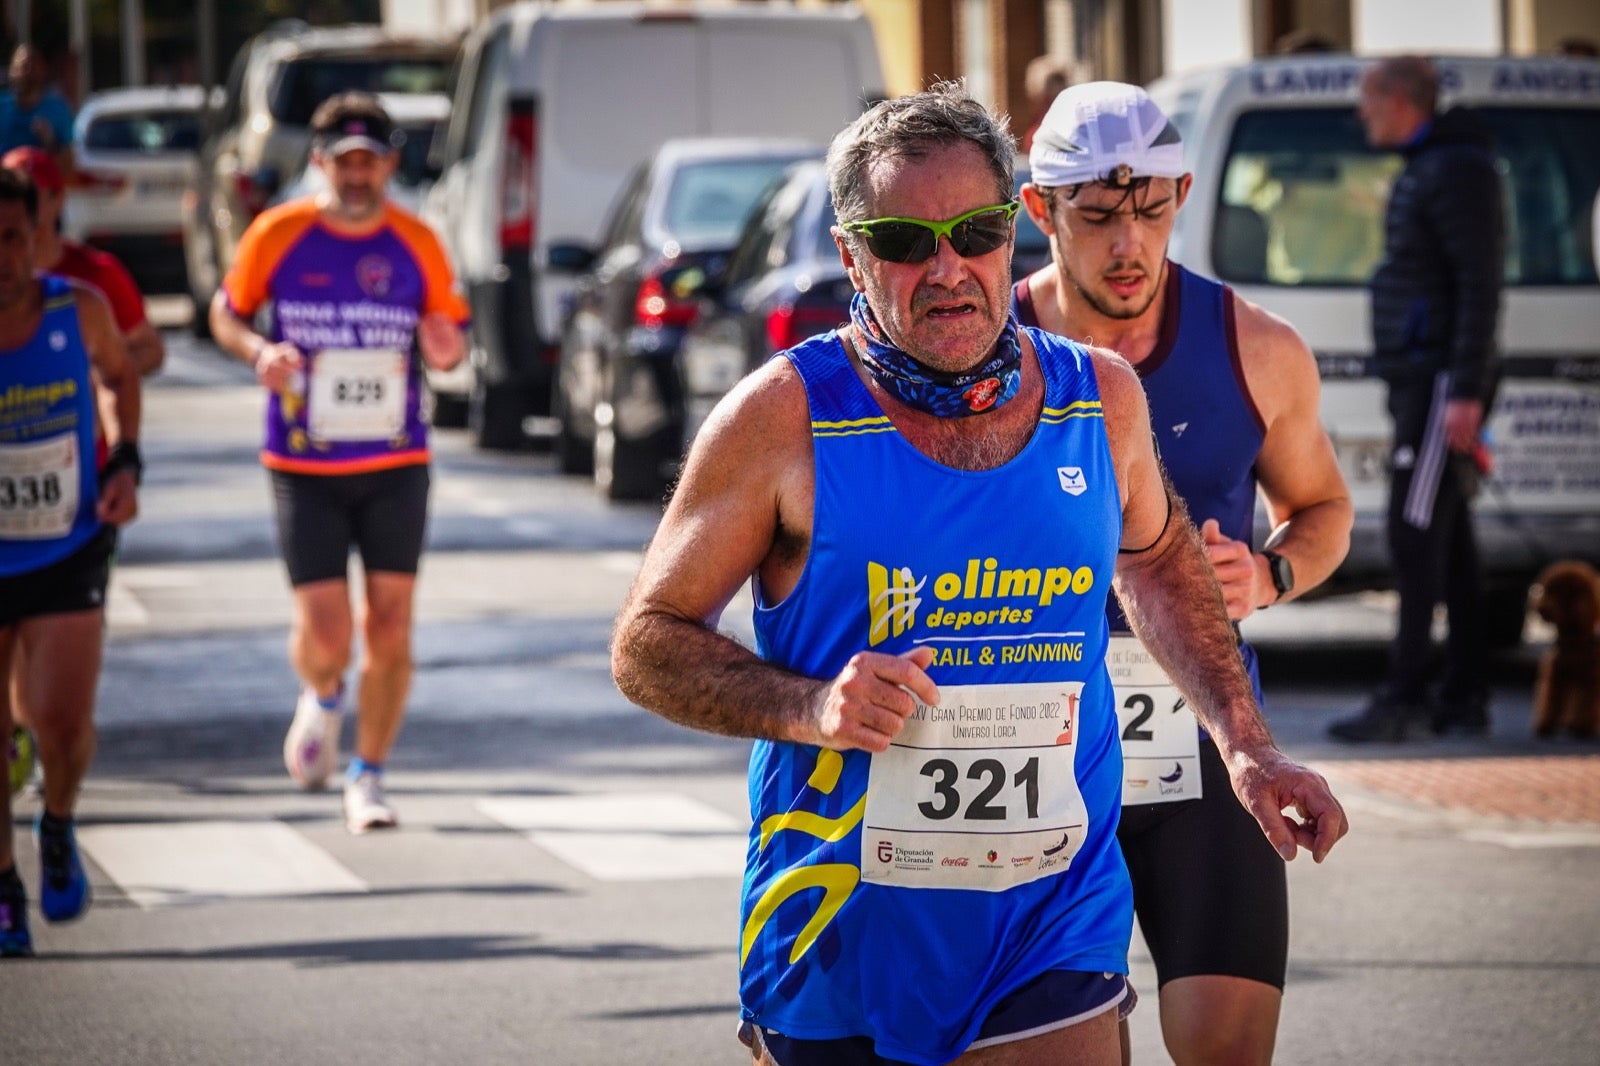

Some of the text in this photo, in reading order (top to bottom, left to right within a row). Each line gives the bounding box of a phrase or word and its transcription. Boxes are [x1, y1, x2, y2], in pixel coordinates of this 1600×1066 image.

[934, 557, 1094, 606] olimpo
[926, 606, 1033, 630] deportes
[930, 643, 1083, 666] RAIL & RUNNING
[931, 705, 956, 722] GRAN
[960, 705, 991, 721] PREMIO
[995, 707, 1006, 720] DE
[1010, 703, 1036, 720] FONDO
[1039, 702, 1060, 719] 2022
[953, 725, 1017, 739] UNIVERSO LORCA
[917, 757, 1040, 821] 321
[895, 847, 934, 857] Diputación
[904, 856, 934, 864] Granada
